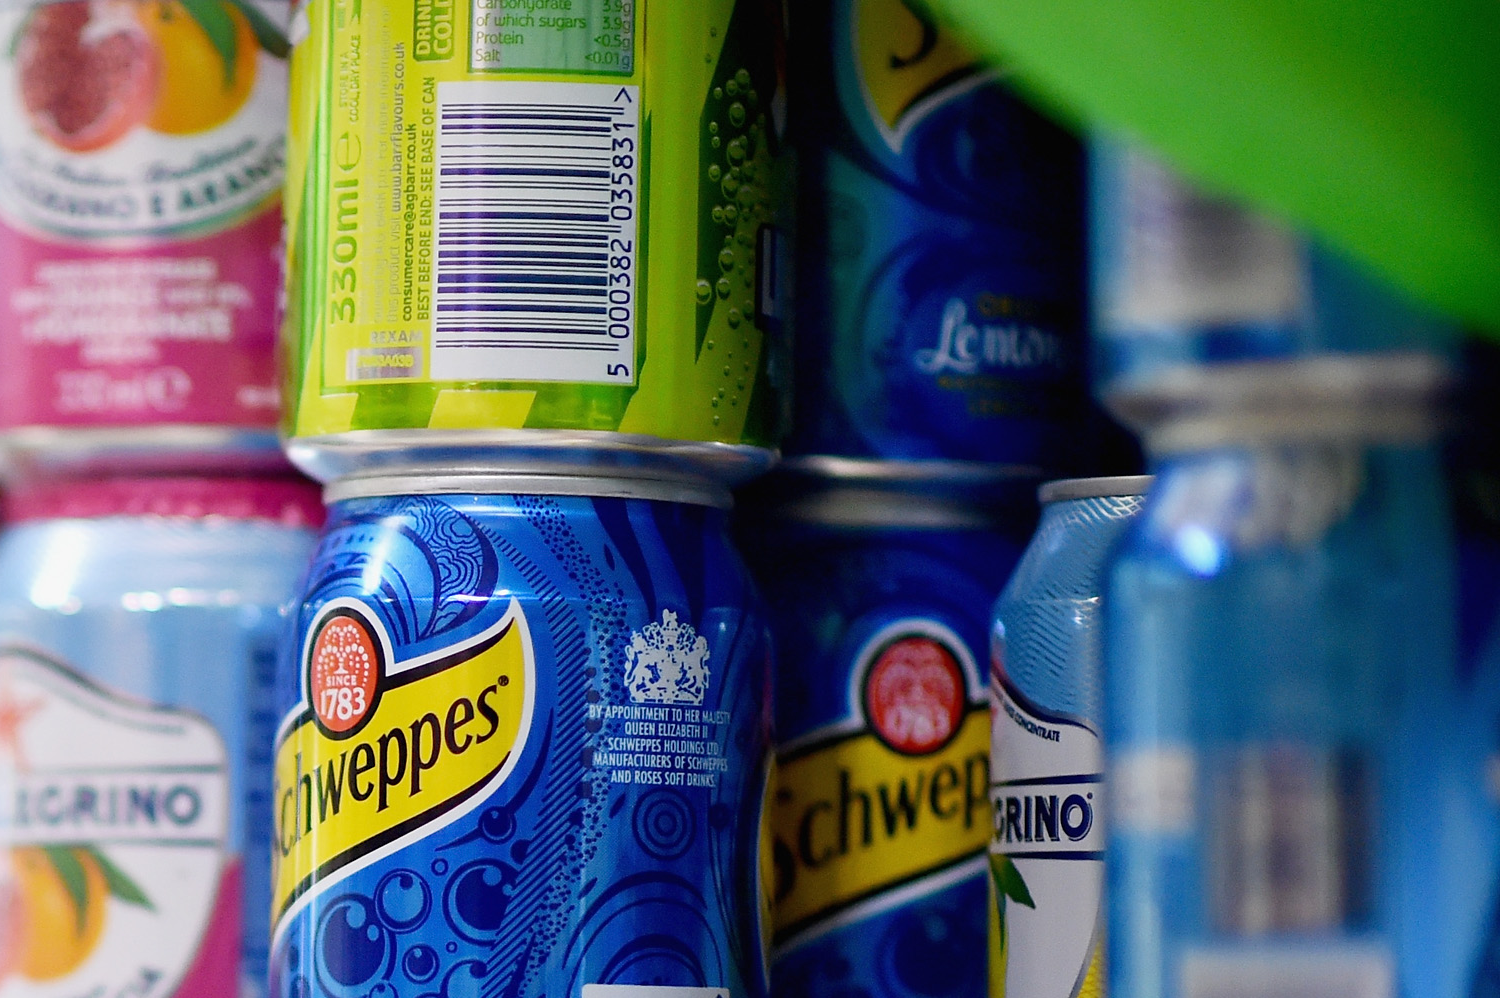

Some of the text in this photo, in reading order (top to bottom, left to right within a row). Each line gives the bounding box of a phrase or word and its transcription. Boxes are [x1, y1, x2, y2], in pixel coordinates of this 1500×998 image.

[476, 15, 490, 28] of
[494, 15, 535, 28] which
[539, 17, 587, 33] sugars
[475, 31, 524, 45] Protein
[475, 48, 501, 62] Salt
[610, 122, 635, 221] 035831
[417, 76, 435, 321] BEST BEFORE END: SEE BASE OF CAN
[402, 123, 418, 322] consumercare@agbarr.co.uk
[331, 178, 359, 325] 330ml
[388, 246, 401, 296] product
[608, 238, 632, 340] 000382
[371, 329, 423, 344] REXAM
[607, 363, 629, 377] 5
[325, 674, 357, 687] SINCE
[320, 687, 366, 721] 1783
[605, 704, 670, 722] APPOINTMENT
[672, 708, 682, 722] TO
[684, 709, 700, 723] HER
[624, 722, 655, 737] QUEEN
[658, 723, 700, 738] ELIZABETH
[608, 737, 661, 753] SCHWEPPES
[664, 740, 704, 755] HOLDINGS
[276, 683, 499, 858] chweppes
[593, 752, 728, 772] MANUFACTURERS OF SCHWEPPES
[611, 770, 716, 788] AND ROSES SOFT DRINKS.
